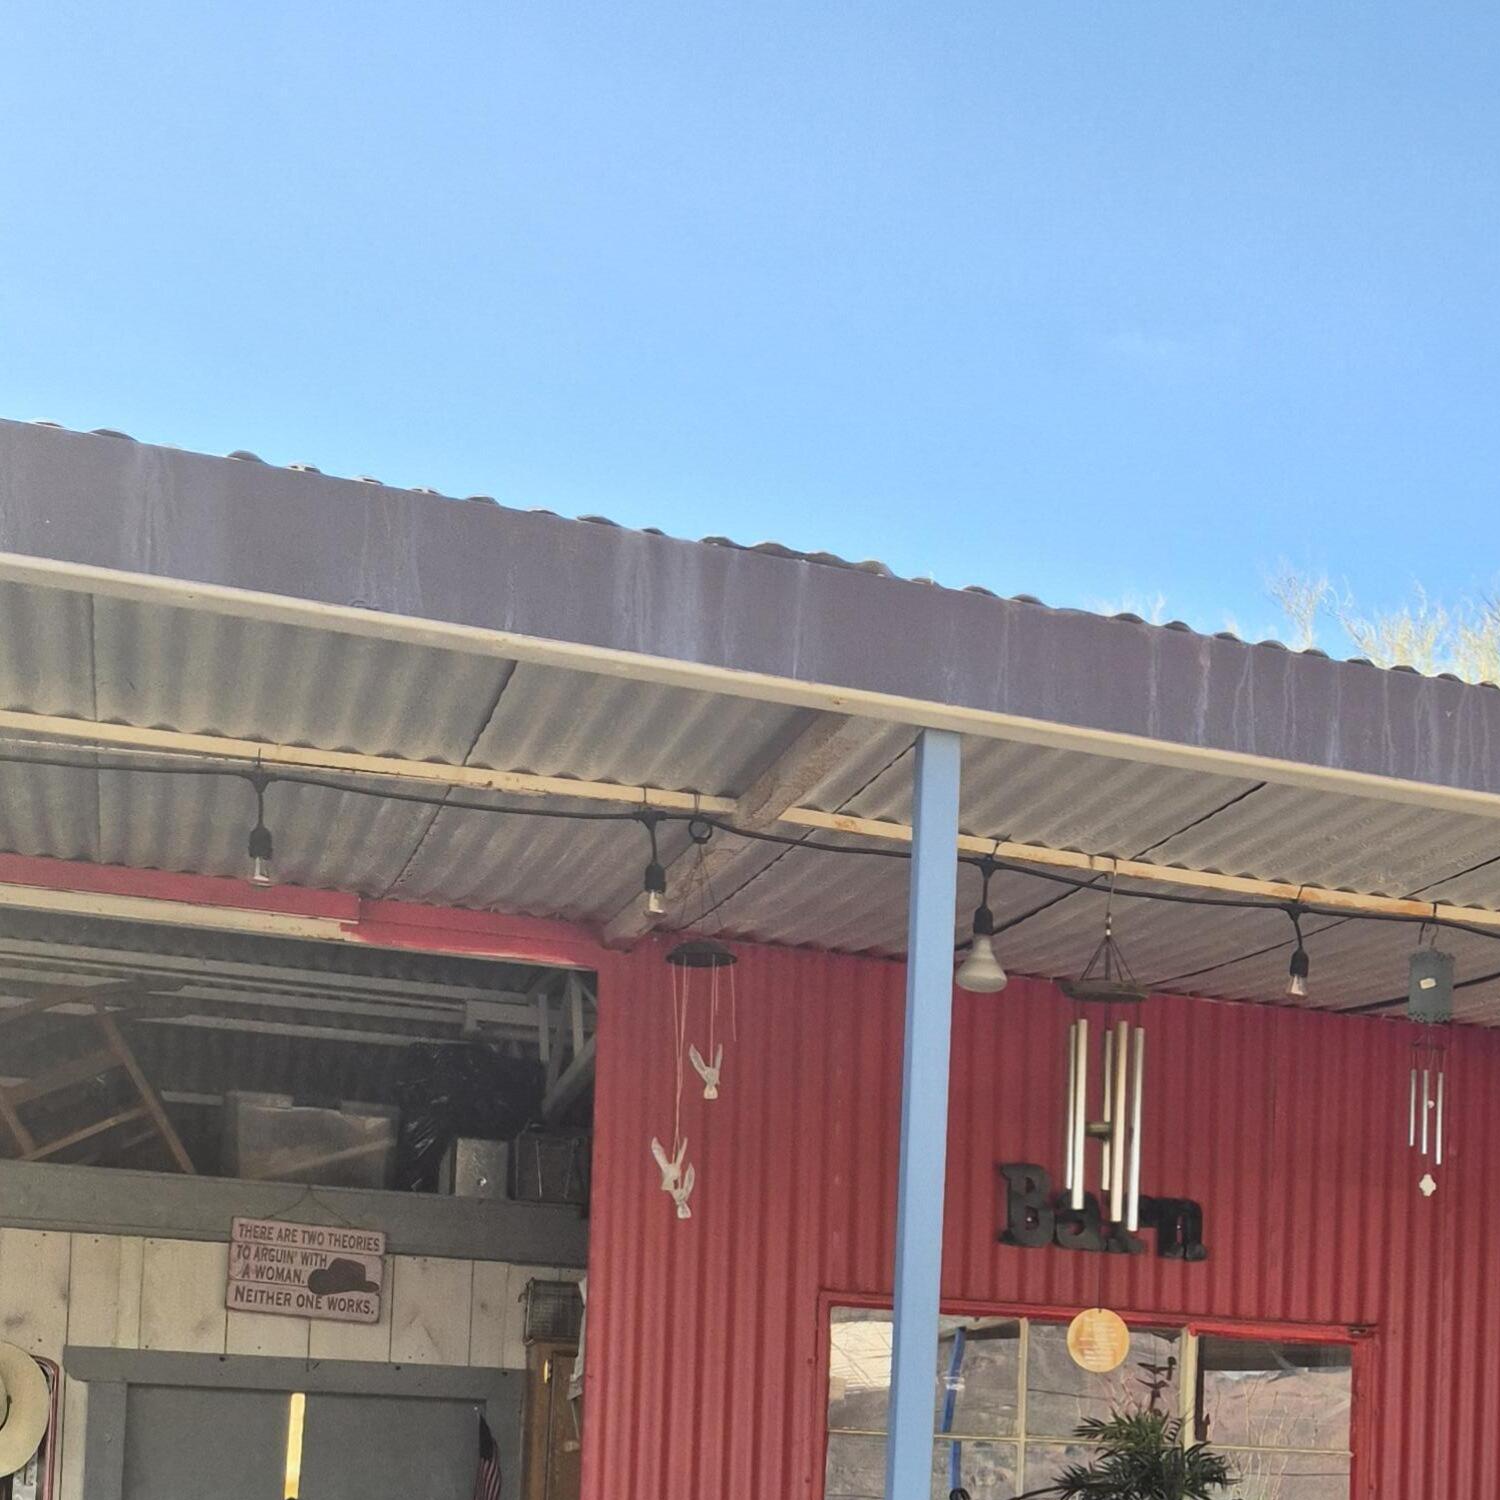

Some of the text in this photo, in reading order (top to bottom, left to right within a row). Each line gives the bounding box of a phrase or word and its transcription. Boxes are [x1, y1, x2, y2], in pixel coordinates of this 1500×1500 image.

[238, 1223, 380, 1252] THERE ARE TWO THEORIES
[237, 1244, 251, 1260] TO
[301, 1251, 328, 1268] WITH
[241, 1263, 305, 1285] A WOMAN.
[296, 1293, 322, 1310] ONE
[327, 1296, 374, 1314] WORKS.
